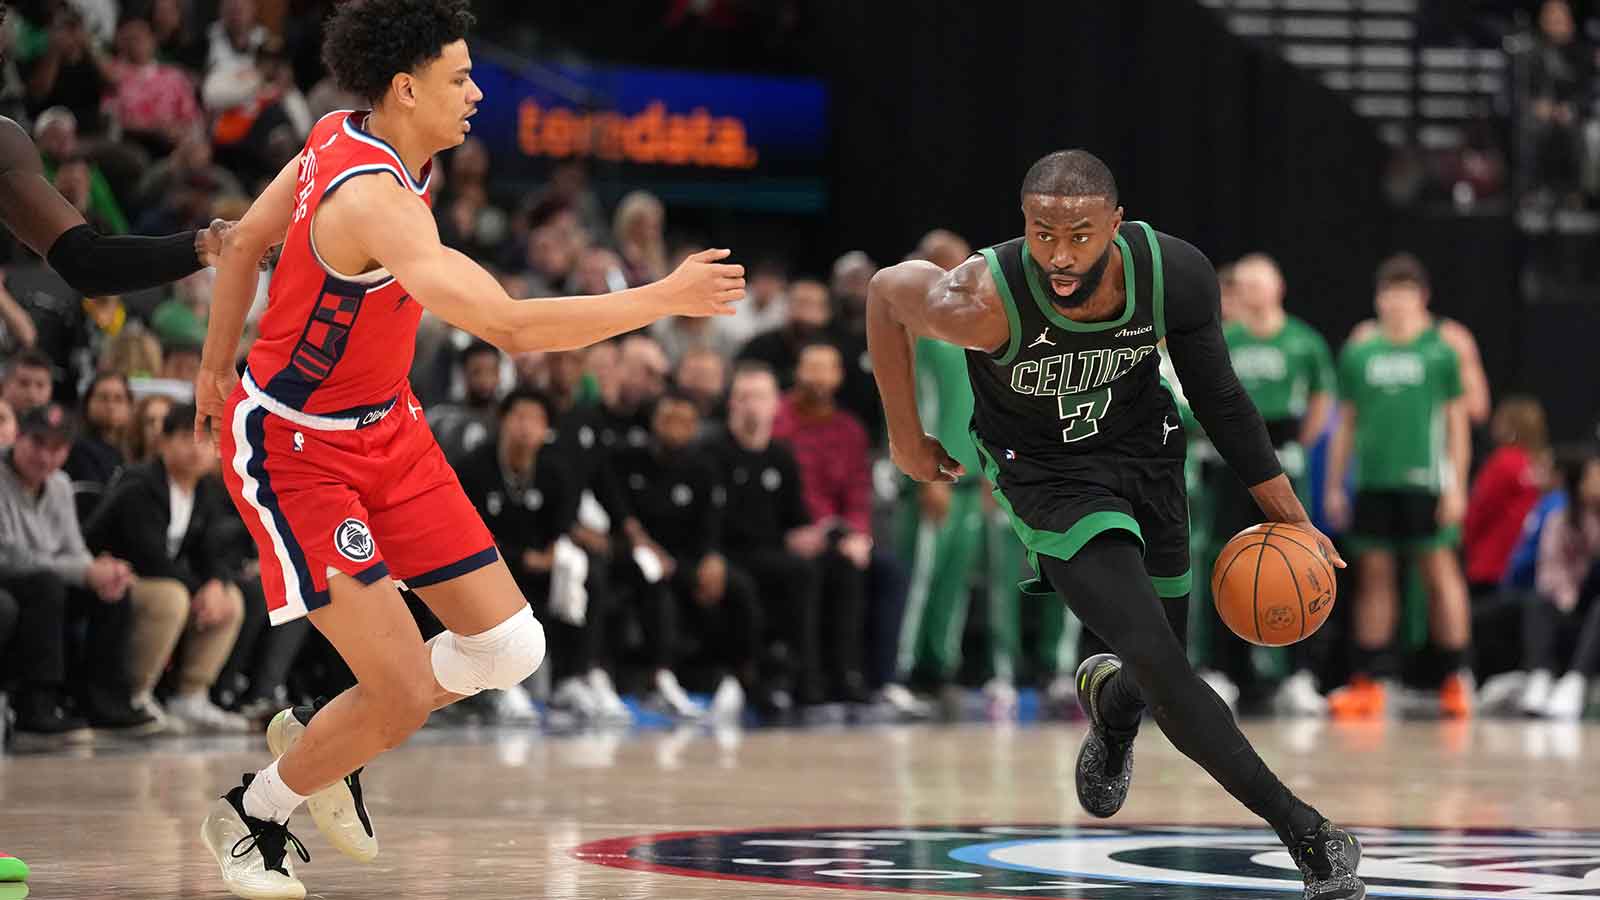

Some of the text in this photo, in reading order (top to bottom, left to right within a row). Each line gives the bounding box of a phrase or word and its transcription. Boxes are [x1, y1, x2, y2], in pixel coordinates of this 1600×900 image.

[518, 97, 758, 168] tedata.
[1115, 325, 1153, 338] Amica
[1057, 387, 1112, 443] 7
